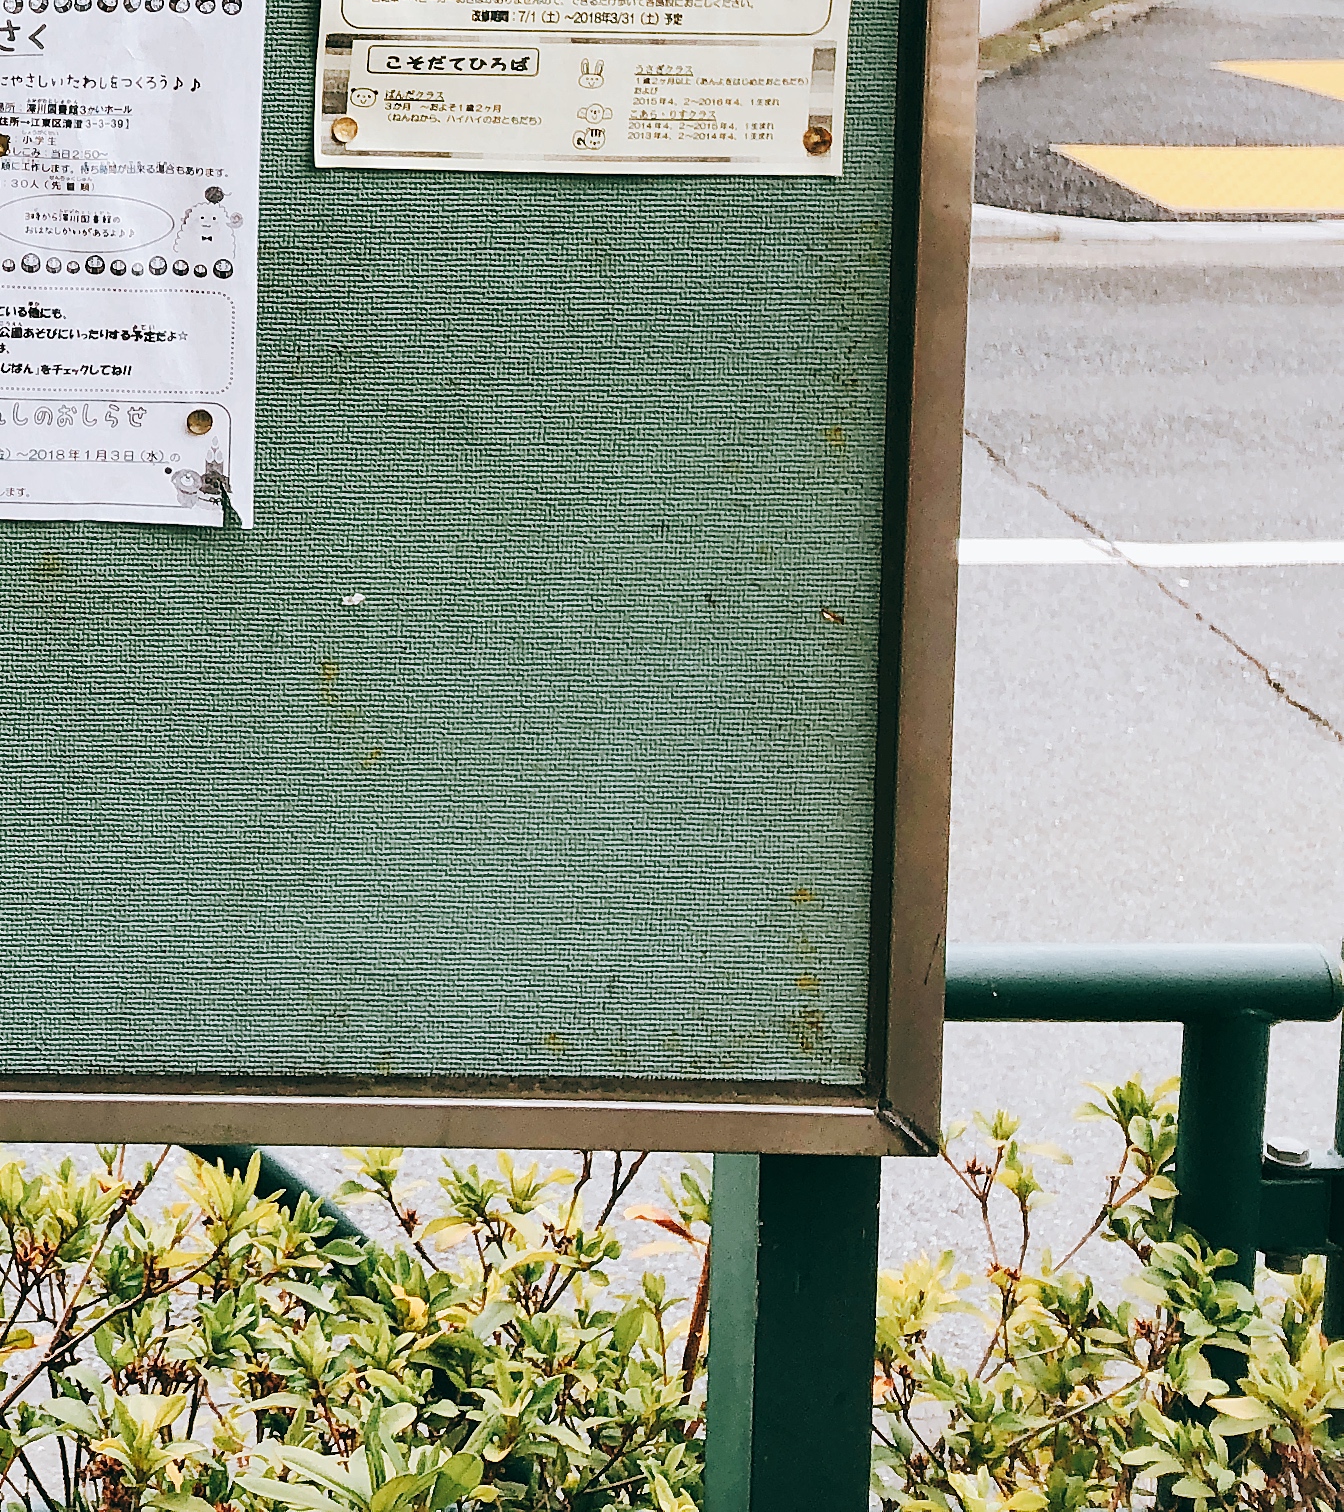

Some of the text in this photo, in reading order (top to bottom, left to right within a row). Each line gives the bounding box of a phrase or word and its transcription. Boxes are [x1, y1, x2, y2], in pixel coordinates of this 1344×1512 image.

[386, 55, 530, 72] こそだてひろば
